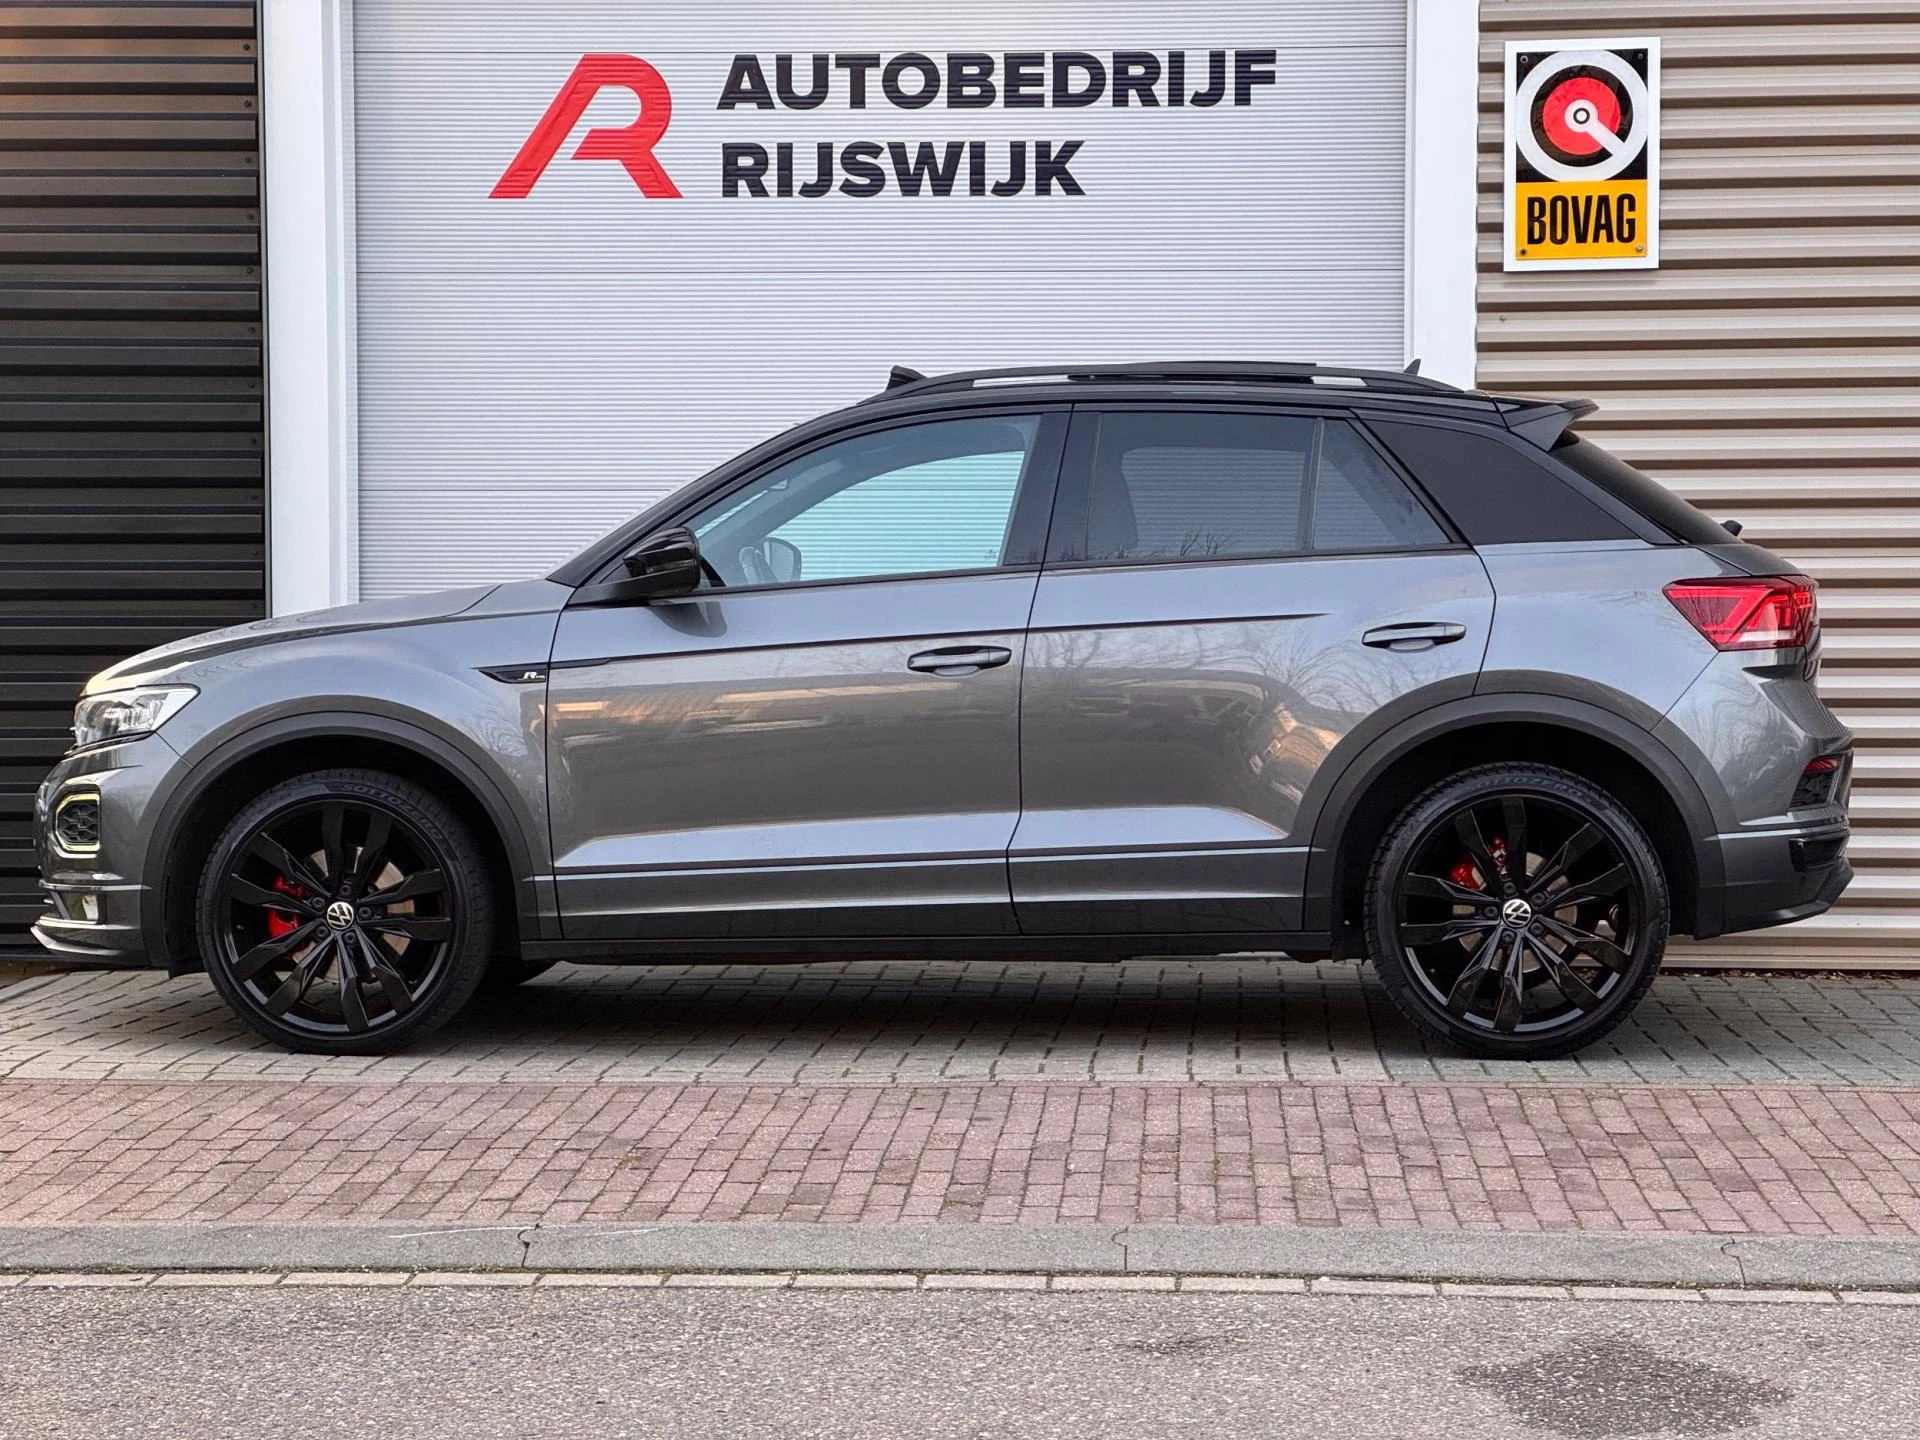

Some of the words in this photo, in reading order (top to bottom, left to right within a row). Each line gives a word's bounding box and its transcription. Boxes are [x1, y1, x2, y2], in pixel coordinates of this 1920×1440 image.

[717, 49, 1277, 110] AUTOBEDRIJF
[722, 140, 1086, 198] RIJSWIJK
[1527, 193, 1636, 245] BOVAG
